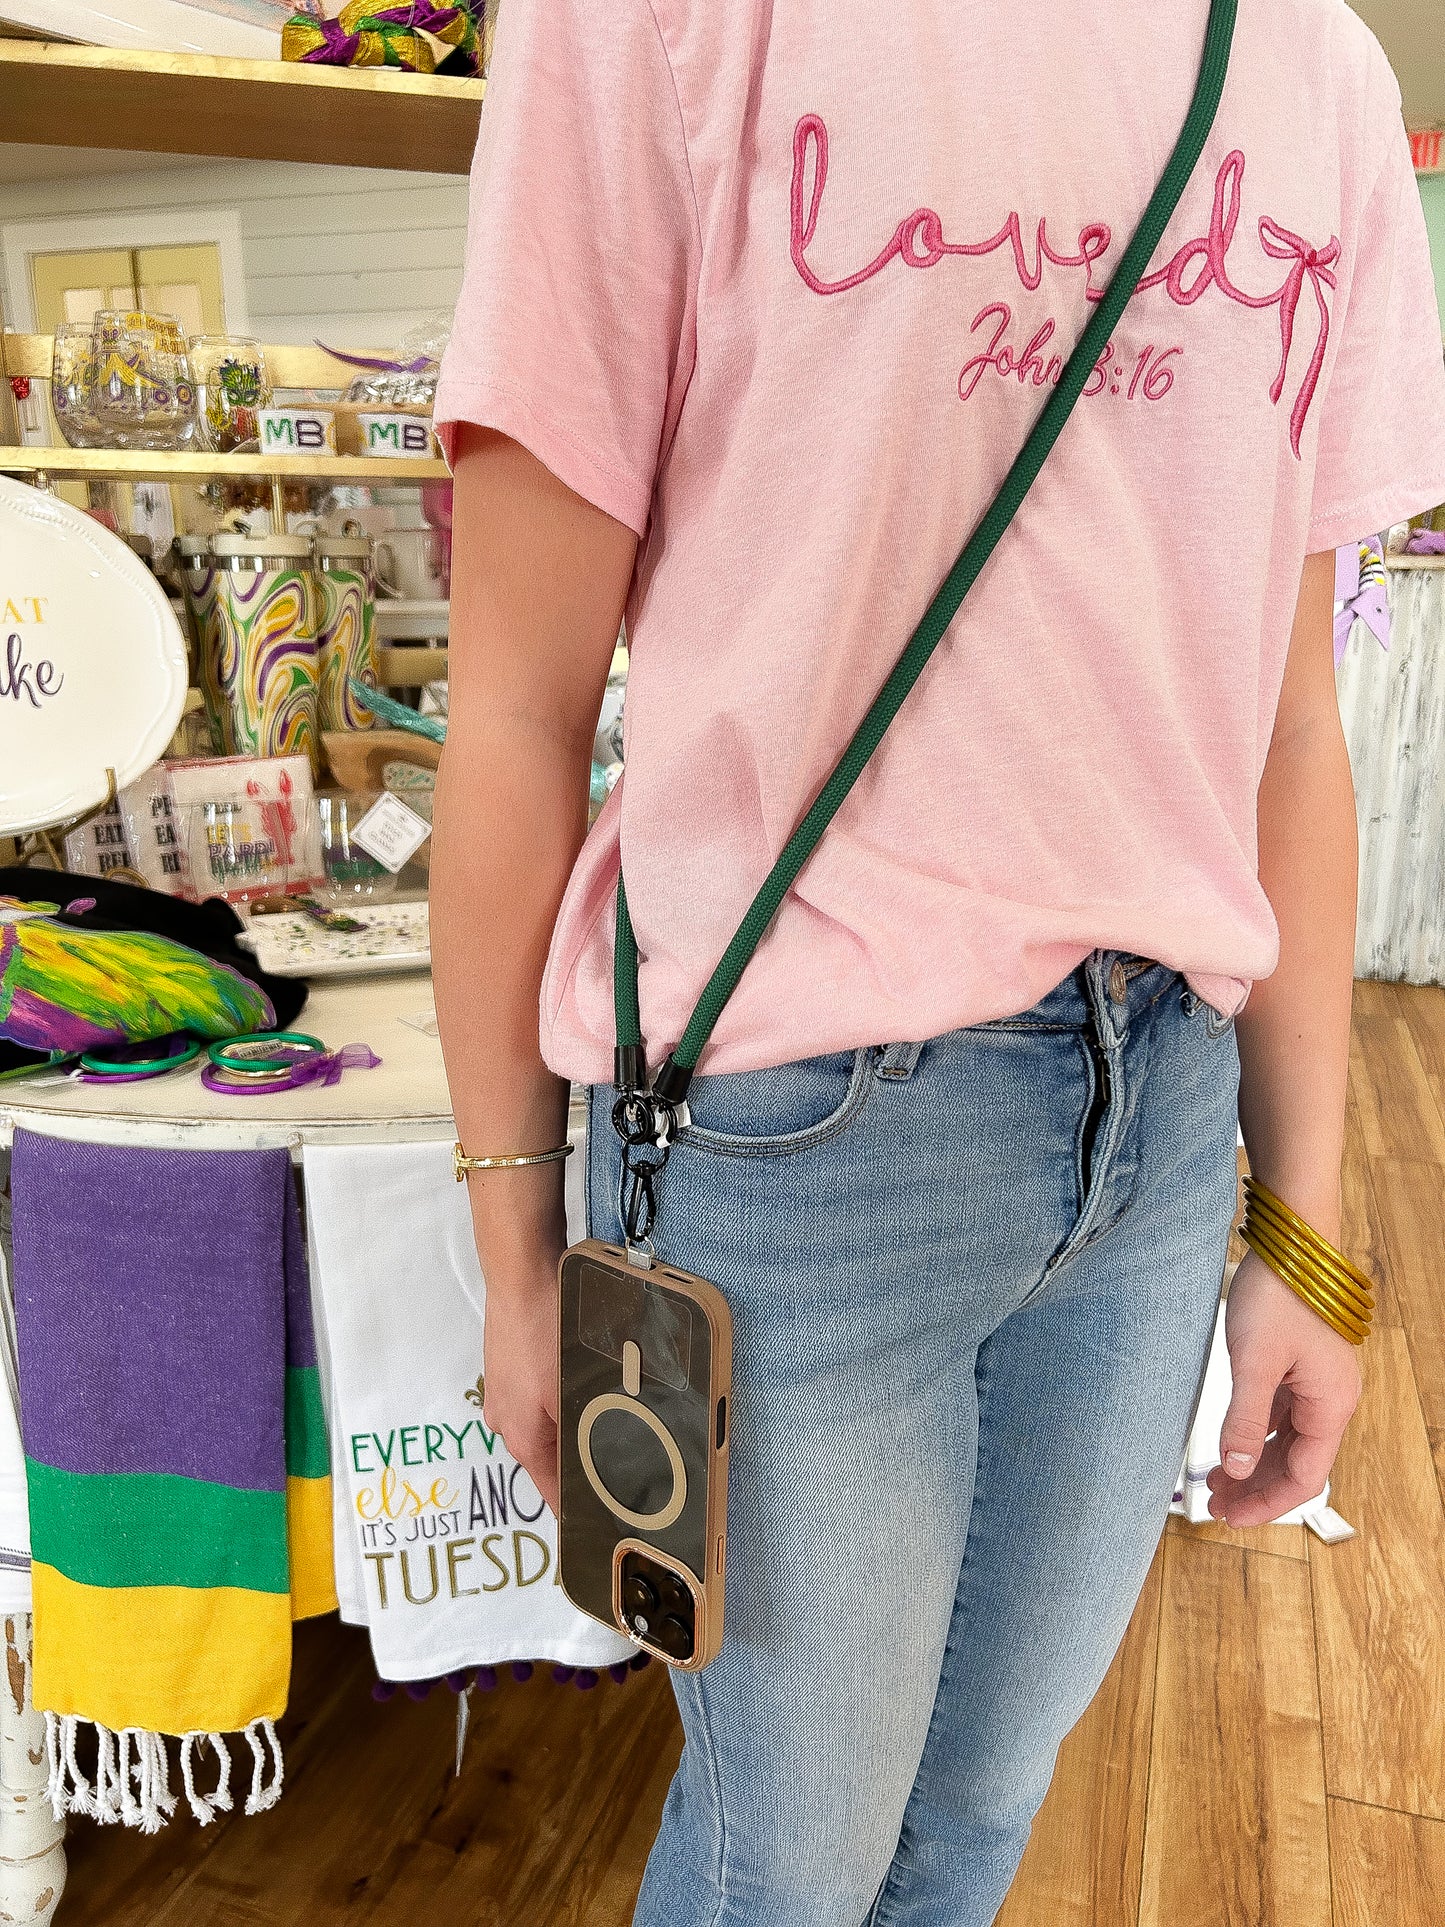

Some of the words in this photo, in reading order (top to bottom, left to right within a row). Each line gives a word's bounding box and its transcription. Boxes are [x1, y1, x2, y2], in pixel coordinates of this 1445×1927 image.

[790, 113, 1302, 309] loved
[957, 301, 1062, 401] John
[1082, 341, 1184, 401] 3:16
[0, 596, 49, 624] AT
[0, 632, 65, 708] ke
[356, 1466, 460, 1520] else
[361, 1516, 397, 1547] IT'S
[405, 1510, 461, 1542] JUST
[364, 1529, 560, 1610] TUESD
